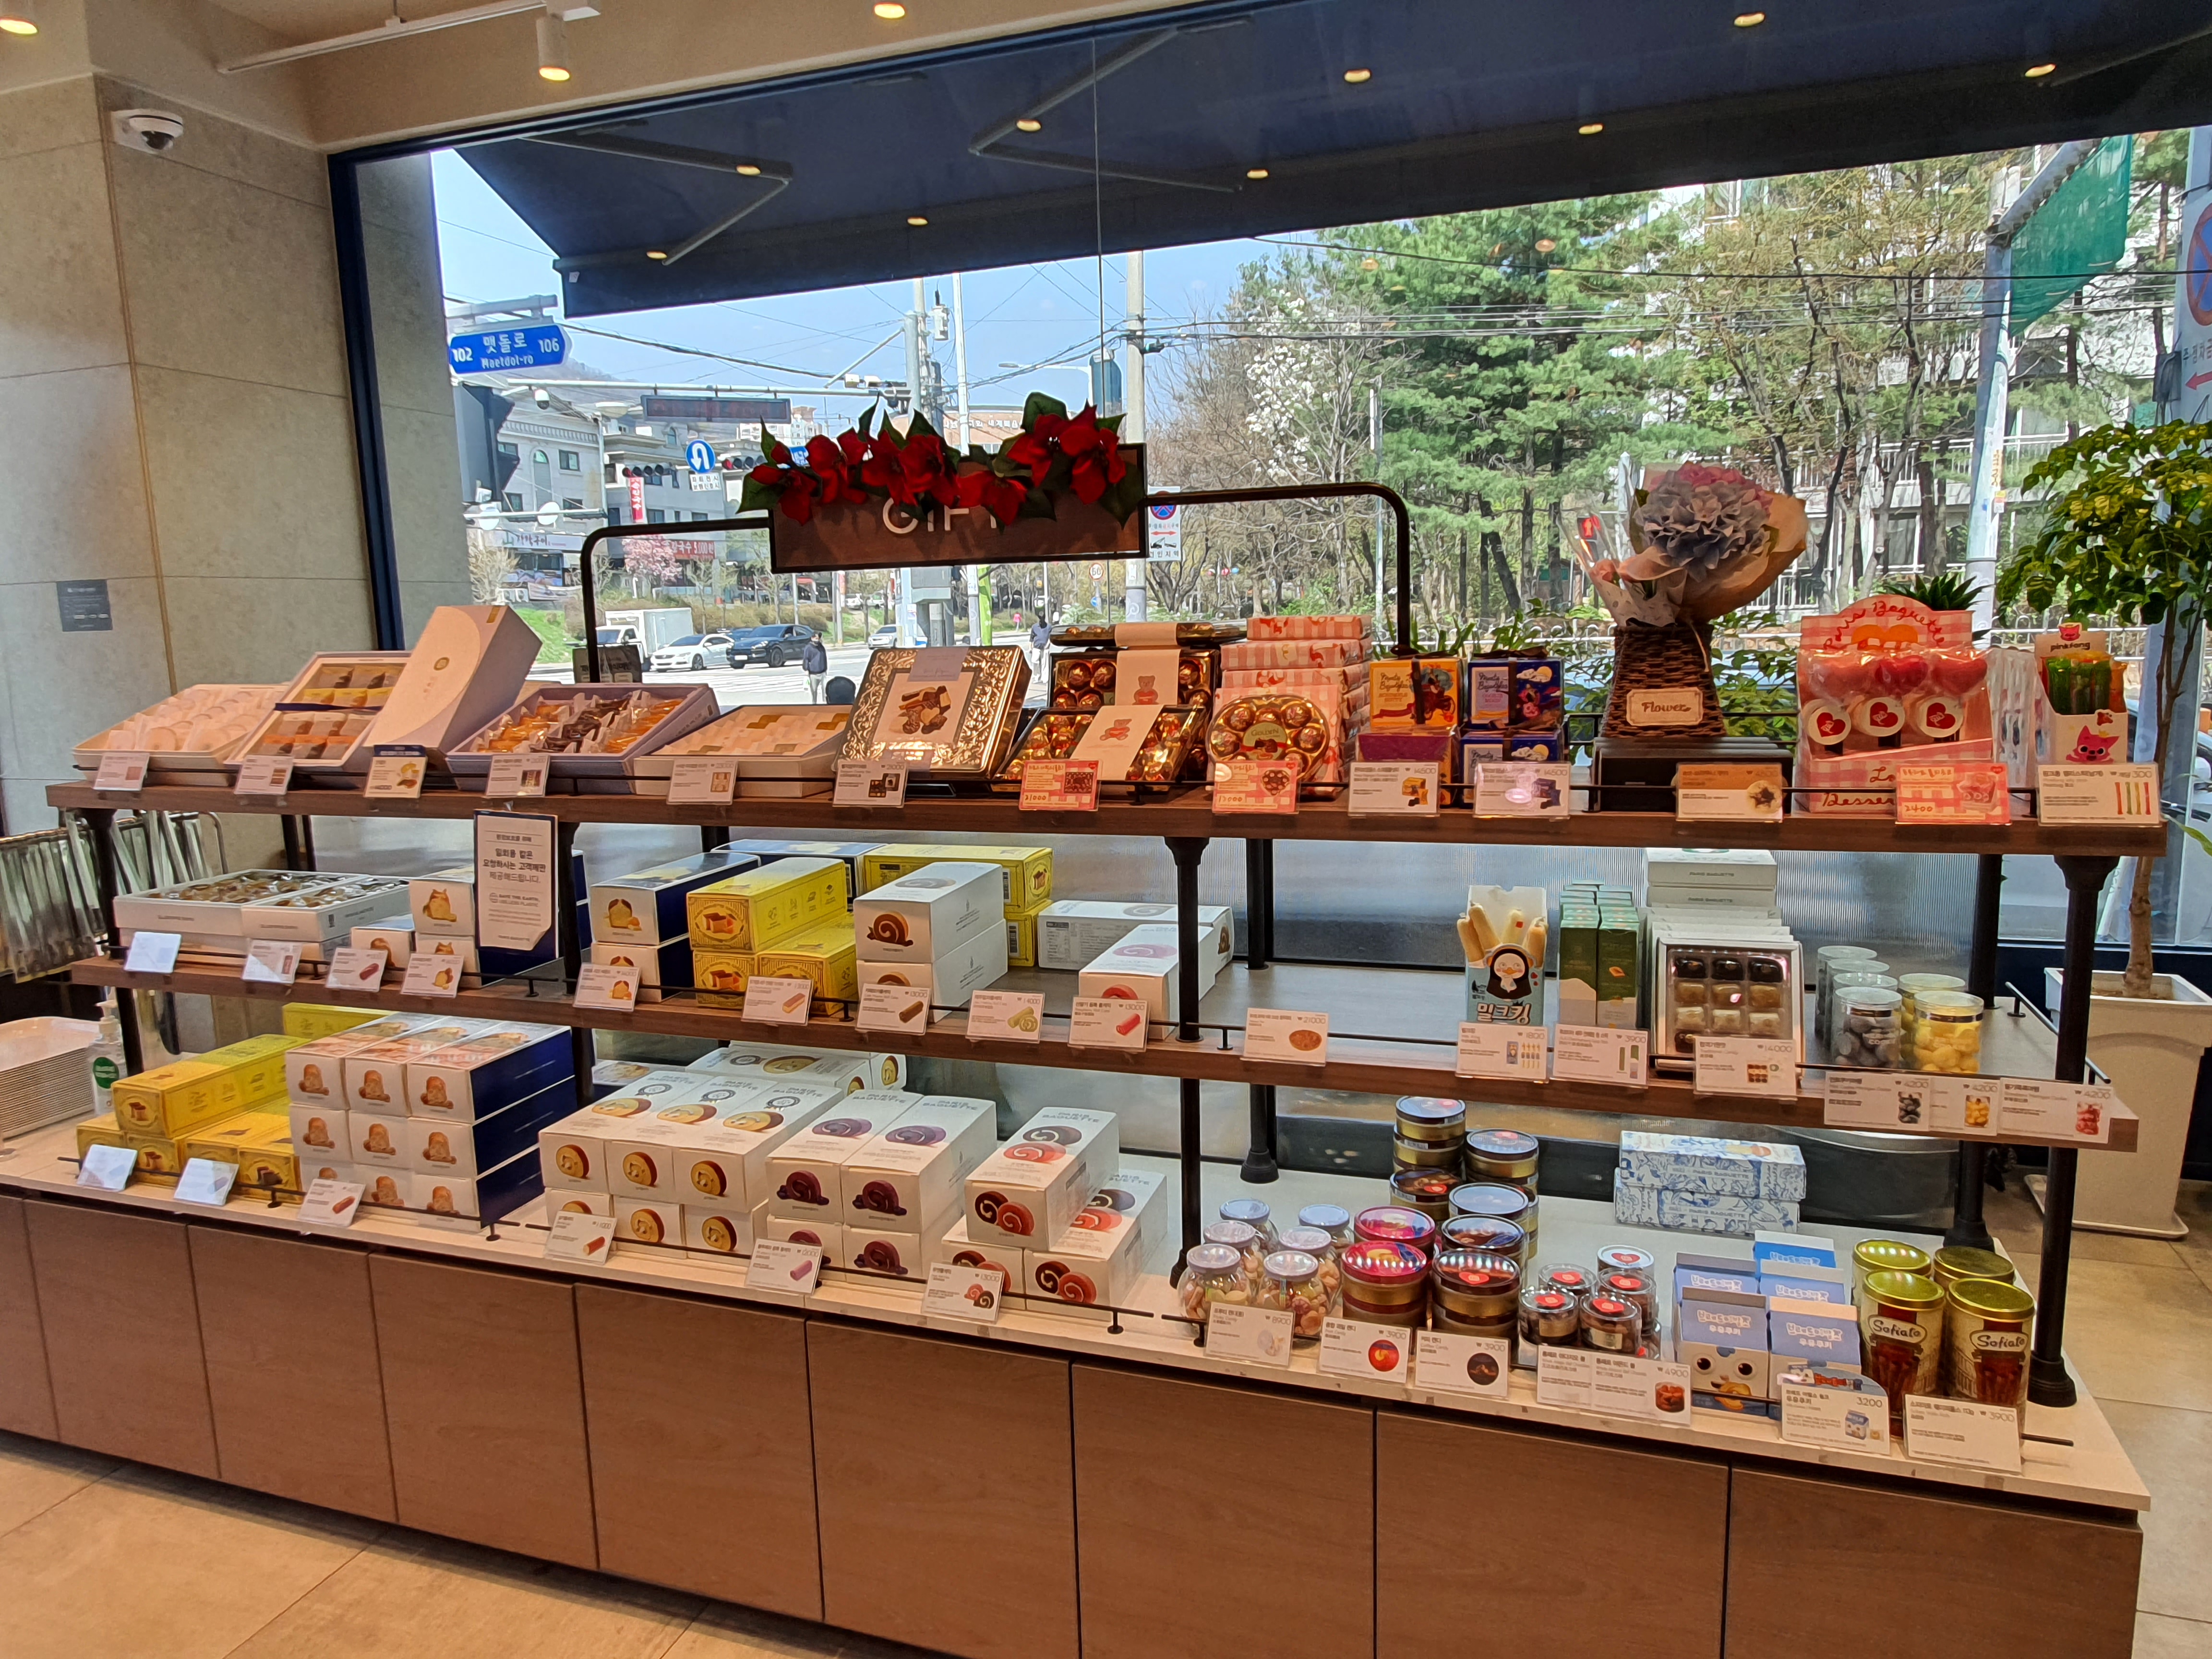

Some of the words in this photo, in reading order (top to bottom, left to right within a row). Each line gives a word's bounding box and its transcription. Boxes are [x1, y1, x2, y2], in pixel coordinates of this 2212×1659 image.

[482, 332, 528, 354] 맷돌로
[539, 337, 560, 354] 106
[451, 347, 473, 363] 102
[481, 355, 534, 369] Maetdol-ro
[1871, 601, 1945, 647] Baguette
[2050, 641, 2091, 652] pinkfong
[1641, 701, 1692, 713] Flower
[2132, 770, 2153, 778] 300
[1822, 792, 1895, 807] Desser
[1477, 1002, 1532, 1025] 밀크킹
[1303, 1016, 1326, 1024] 21000
[1624, 1035, 1647, 1044] 3900
[1764, 1045, 1792, 1053] 14000
[1904, 1078, 1929, 1089] 4200
[1972, 1083, 1998, 1093] 4200
[2084, 1089, 2111, 1099] 4200
[1272, 1316, 1291, 1325] 8900
[1385, 1330, 1407, 1340] 3900
[1484, 1342, 1506, 1352] 3900
[1664, 1368, 1689, 1378] 4900
[1856, 1396, 1883, 1408] 3200
[1988, 1411, 2015, 1423] 3900
